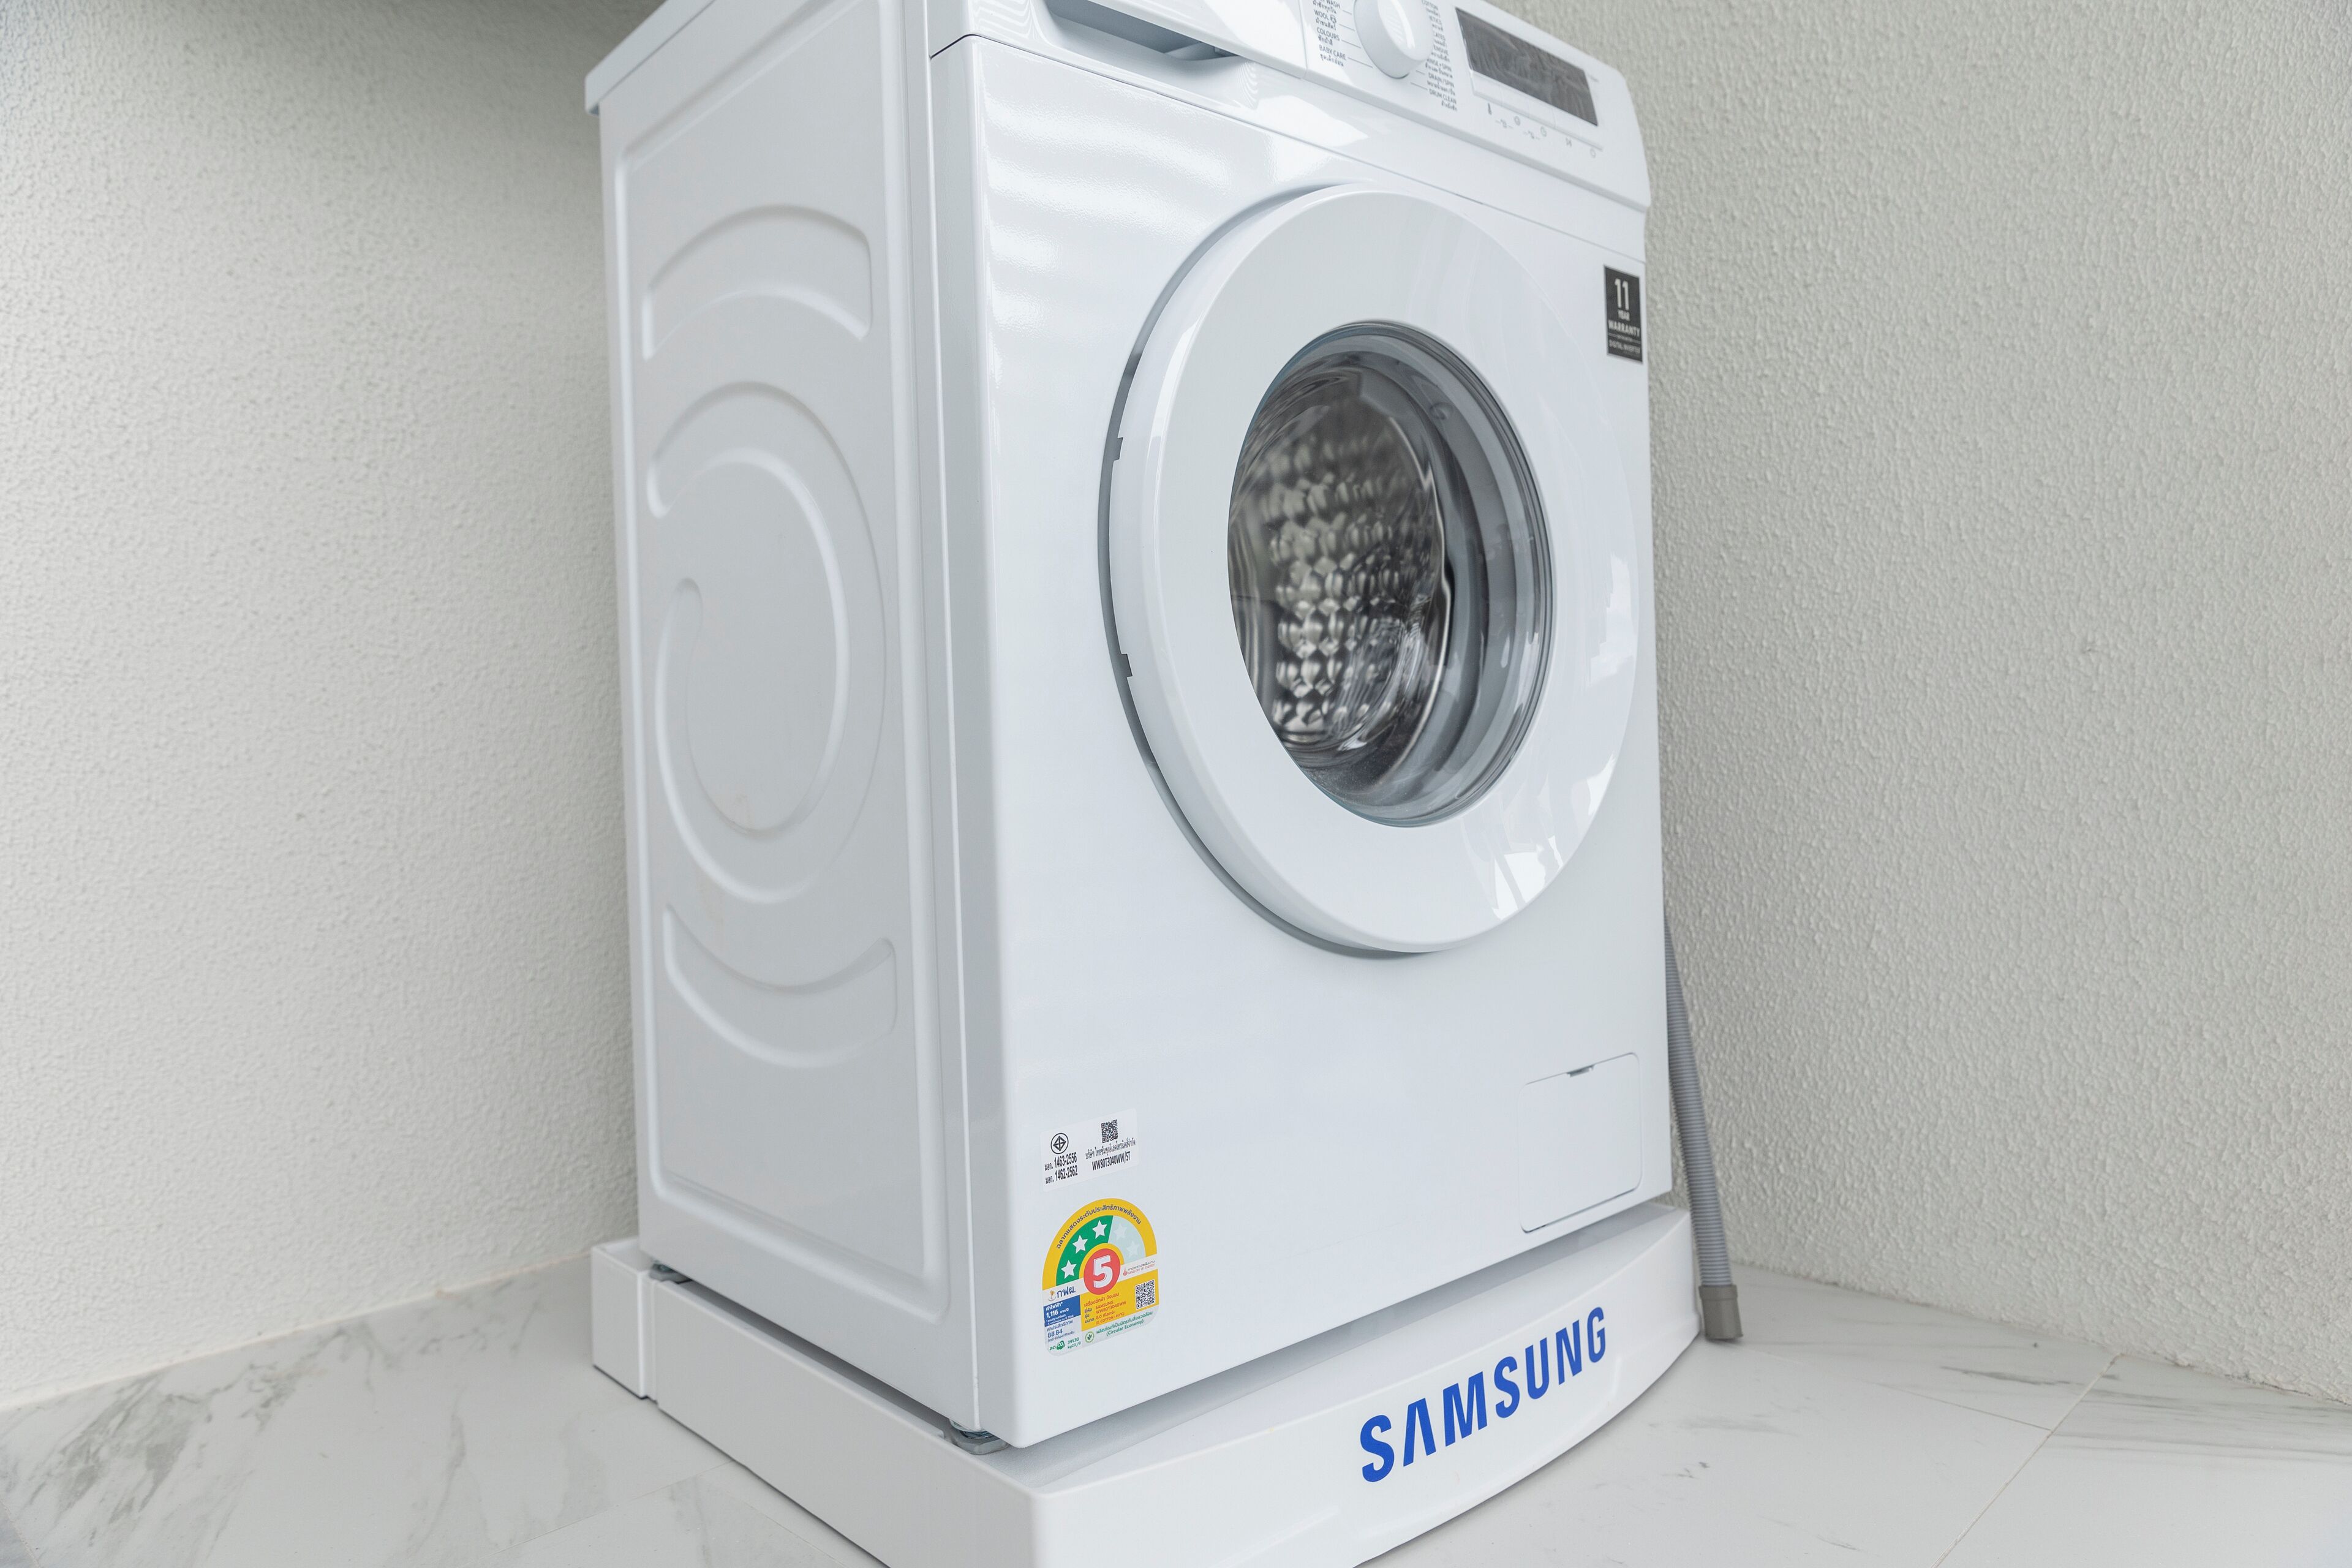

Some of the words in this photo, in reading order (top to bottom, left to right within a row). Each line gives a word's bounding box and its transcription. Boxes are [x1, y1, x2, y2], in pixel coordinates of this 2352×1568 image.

[1314, 9, 1329, 20] WOOL
[1317, 27, 1340, 41] COLOURS
[1319, 45, 1332, 55] BABY
[1333, 50, 1346, 61] CARE
[1443, 94, 1457, 104] CLEAN
[1615, 278, 1629, 311] 11
[1608, 318, 1641, 337] WARRANTY
[1054, 1152, 1077, 1168] 1463-2556
[1092, 1152, 1130, 1170] WW80T3040WW/ST
[1055, 1165, 1078, 1182] 1462-2562
[1093, 1255, 1113, 1289] 5
[1057, 1286, 1076, 1298] กฟผ.
[1096, 1300, 1114, 1310] SAMSUNG
[1046, 1310, 1058, 1318] 1,116
[1106, 1325, 1123, 1336] (Circular
[1124, 1319, 1144, 1330] Economy)
[1360, 1306, 1606, 1483] SAMSUNG
